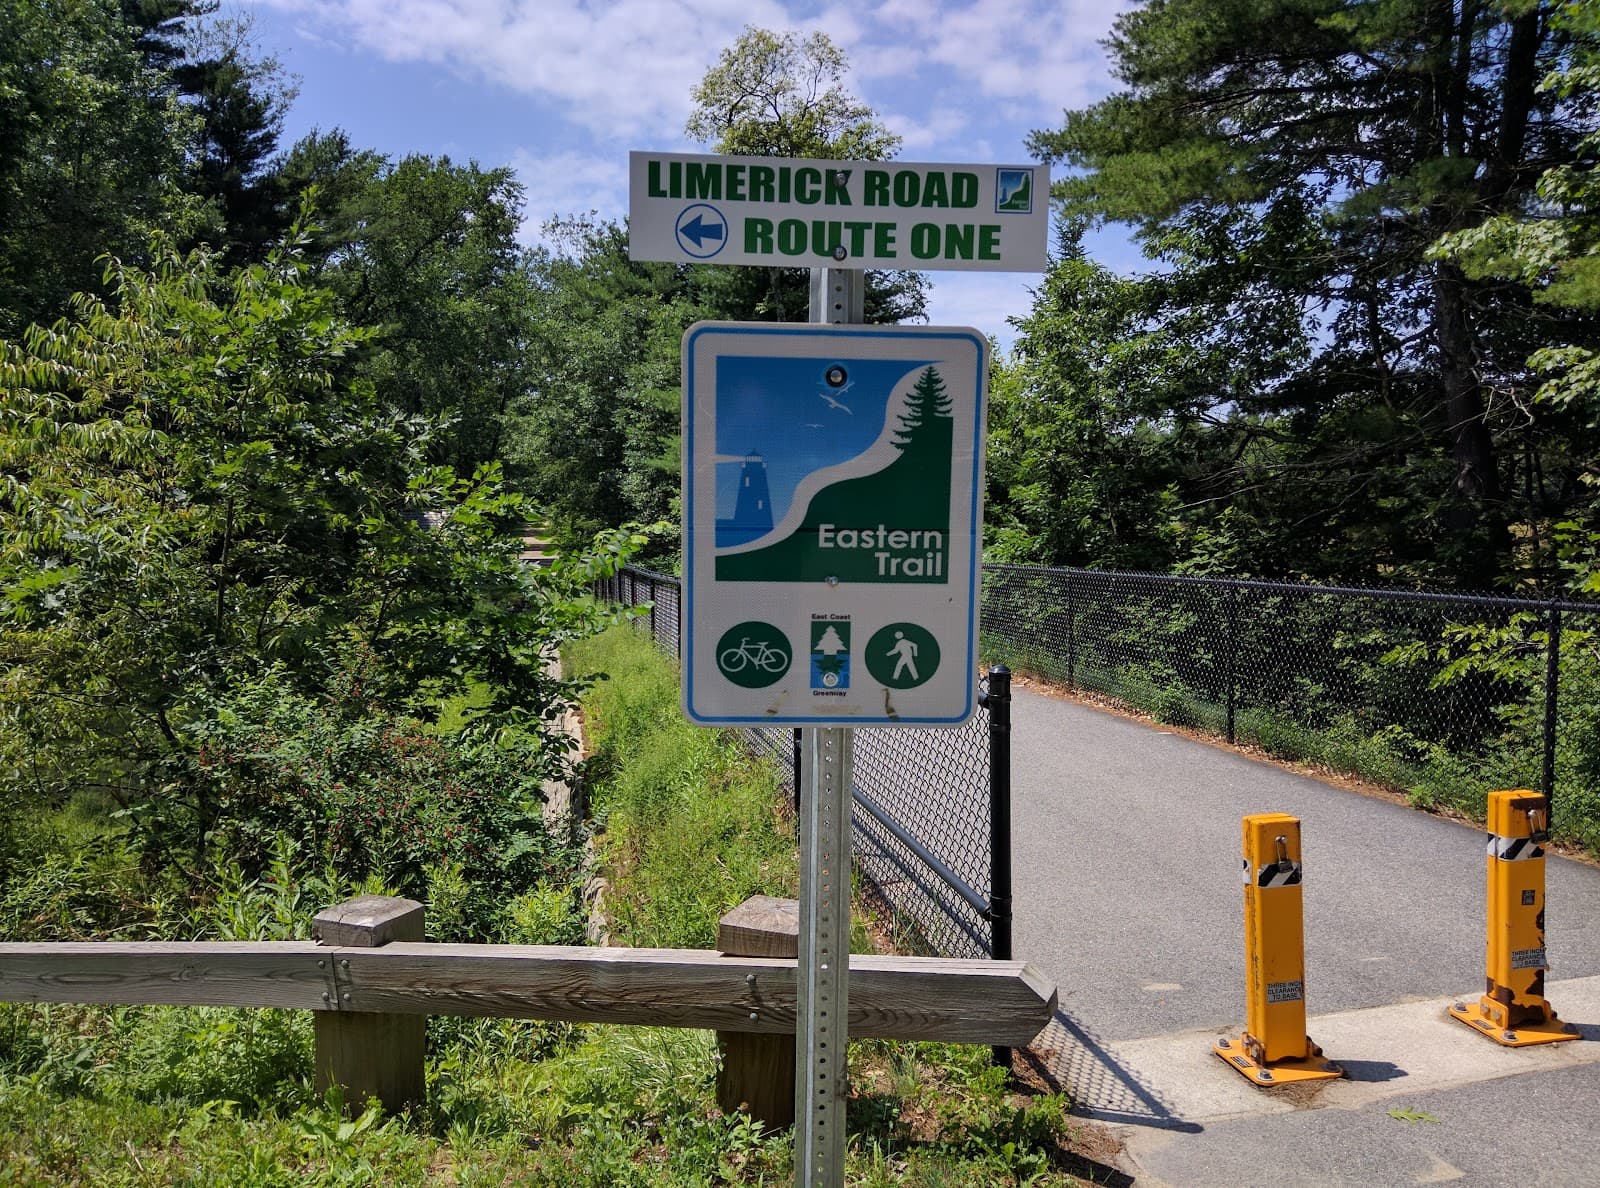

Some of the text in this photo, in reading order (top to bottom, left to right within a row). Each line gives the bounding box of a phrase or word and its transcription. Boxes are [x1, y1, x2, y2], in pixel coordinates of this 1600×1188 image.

[648, 160, 979, 208] LIMERICK ROAD
[744, 217, 1001, 260] ROUTE ONE
[818, 523, 943, 549] Eastern
[874, 551, 942, 576] Trail
